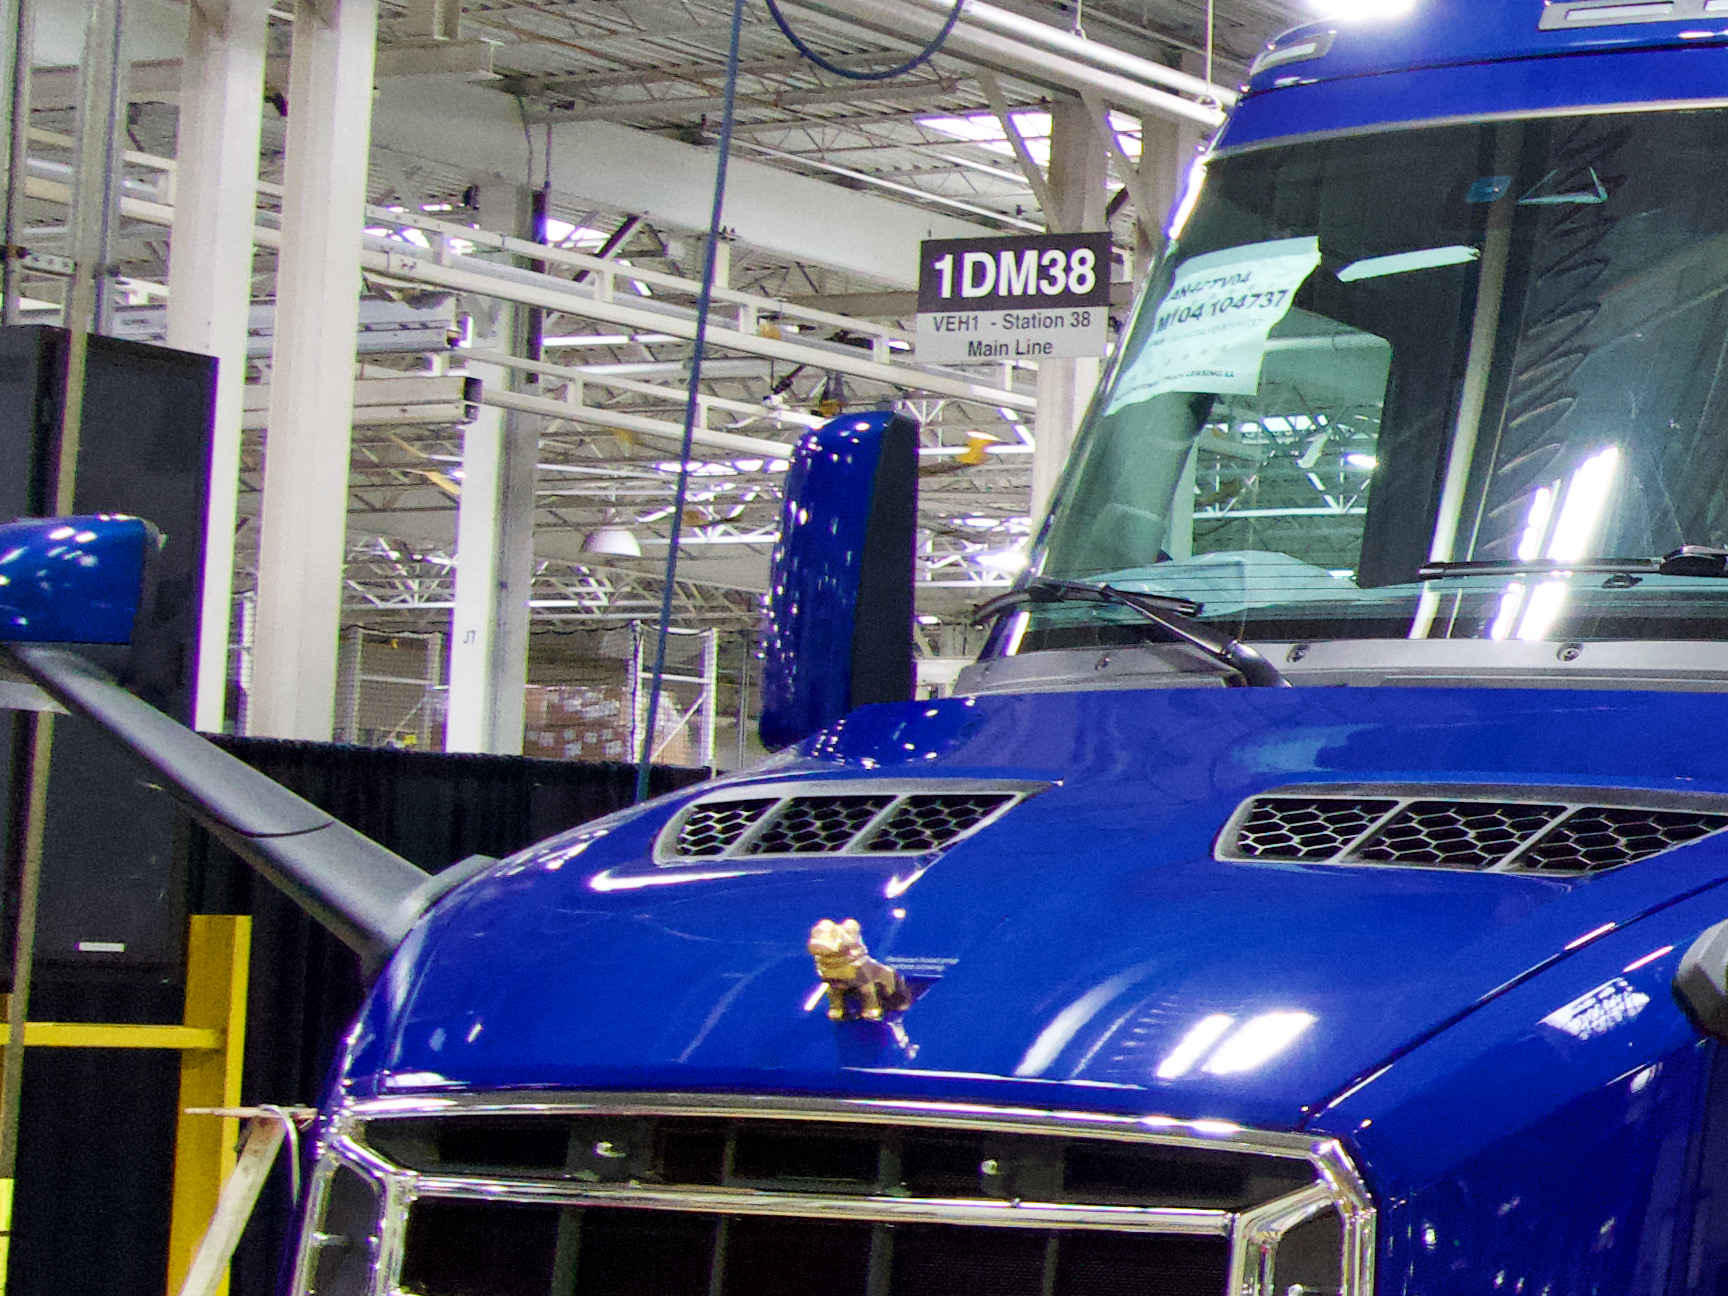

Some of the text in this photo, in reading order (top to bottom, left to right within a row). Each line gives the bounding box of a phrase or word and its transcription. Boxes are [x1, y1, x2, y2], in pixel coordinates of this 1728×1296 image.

[933, 247, 1097, 300] 1DM38
[934, 314, 979, 333] VEH1
[1002, 312, 1064, 330] Station
[1071, 310, 1092, 328] 38
[968, 338, 1053, 357] Main Line
